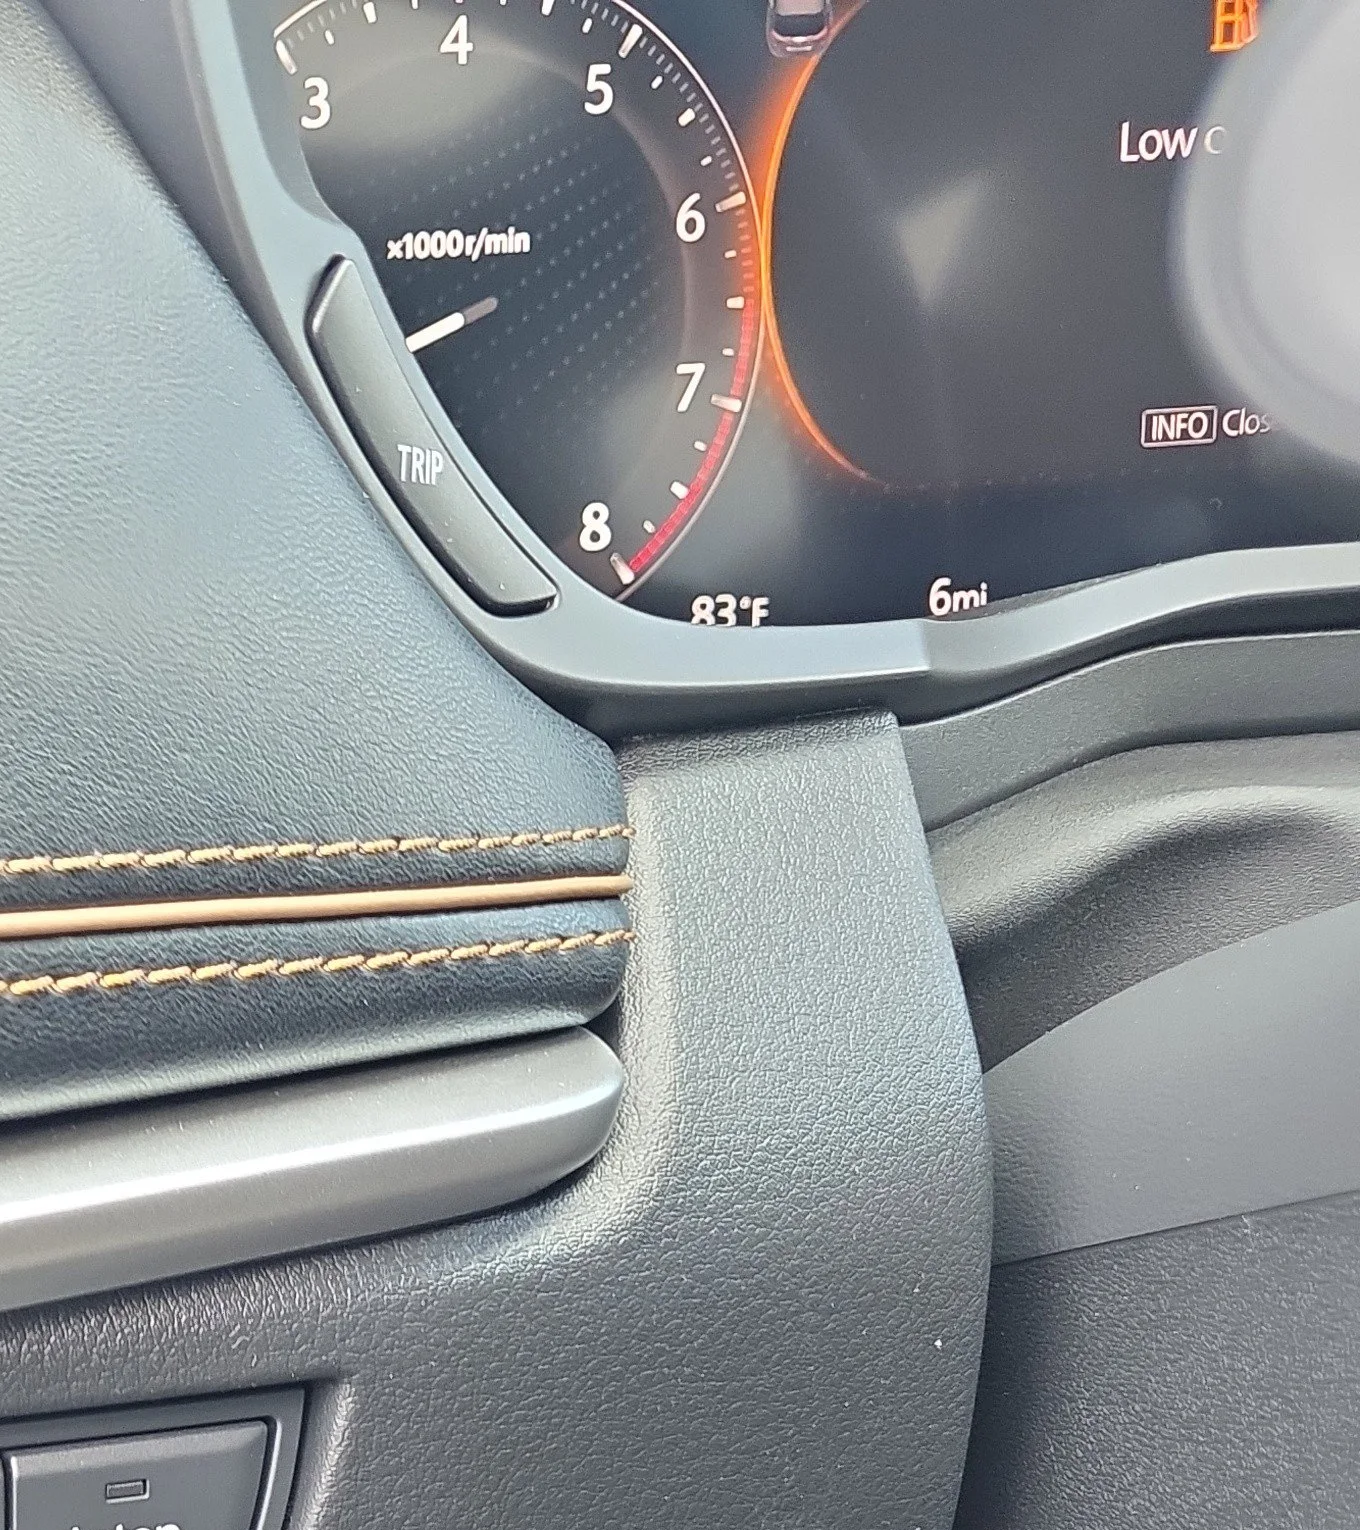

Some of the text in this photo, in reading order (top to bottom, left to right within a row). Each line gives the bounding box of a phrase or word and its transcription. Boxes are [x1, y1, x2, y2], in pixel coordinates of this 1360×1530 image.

[440, 15, 473, 64] 4
[301, 77, 331, 129] 3
[584, 63, 613, 115] 5
[1120, 121, 1198, 162] Low
[676, 192, 705, 242] 6
[676, 362, 706, 412] 7
[1150, 411, 1209, 441] INFO
[397, 444, 445, 485] TRIP
[580, 502, 612, 552] 8
[930, 577, 988, 616] 6mi
